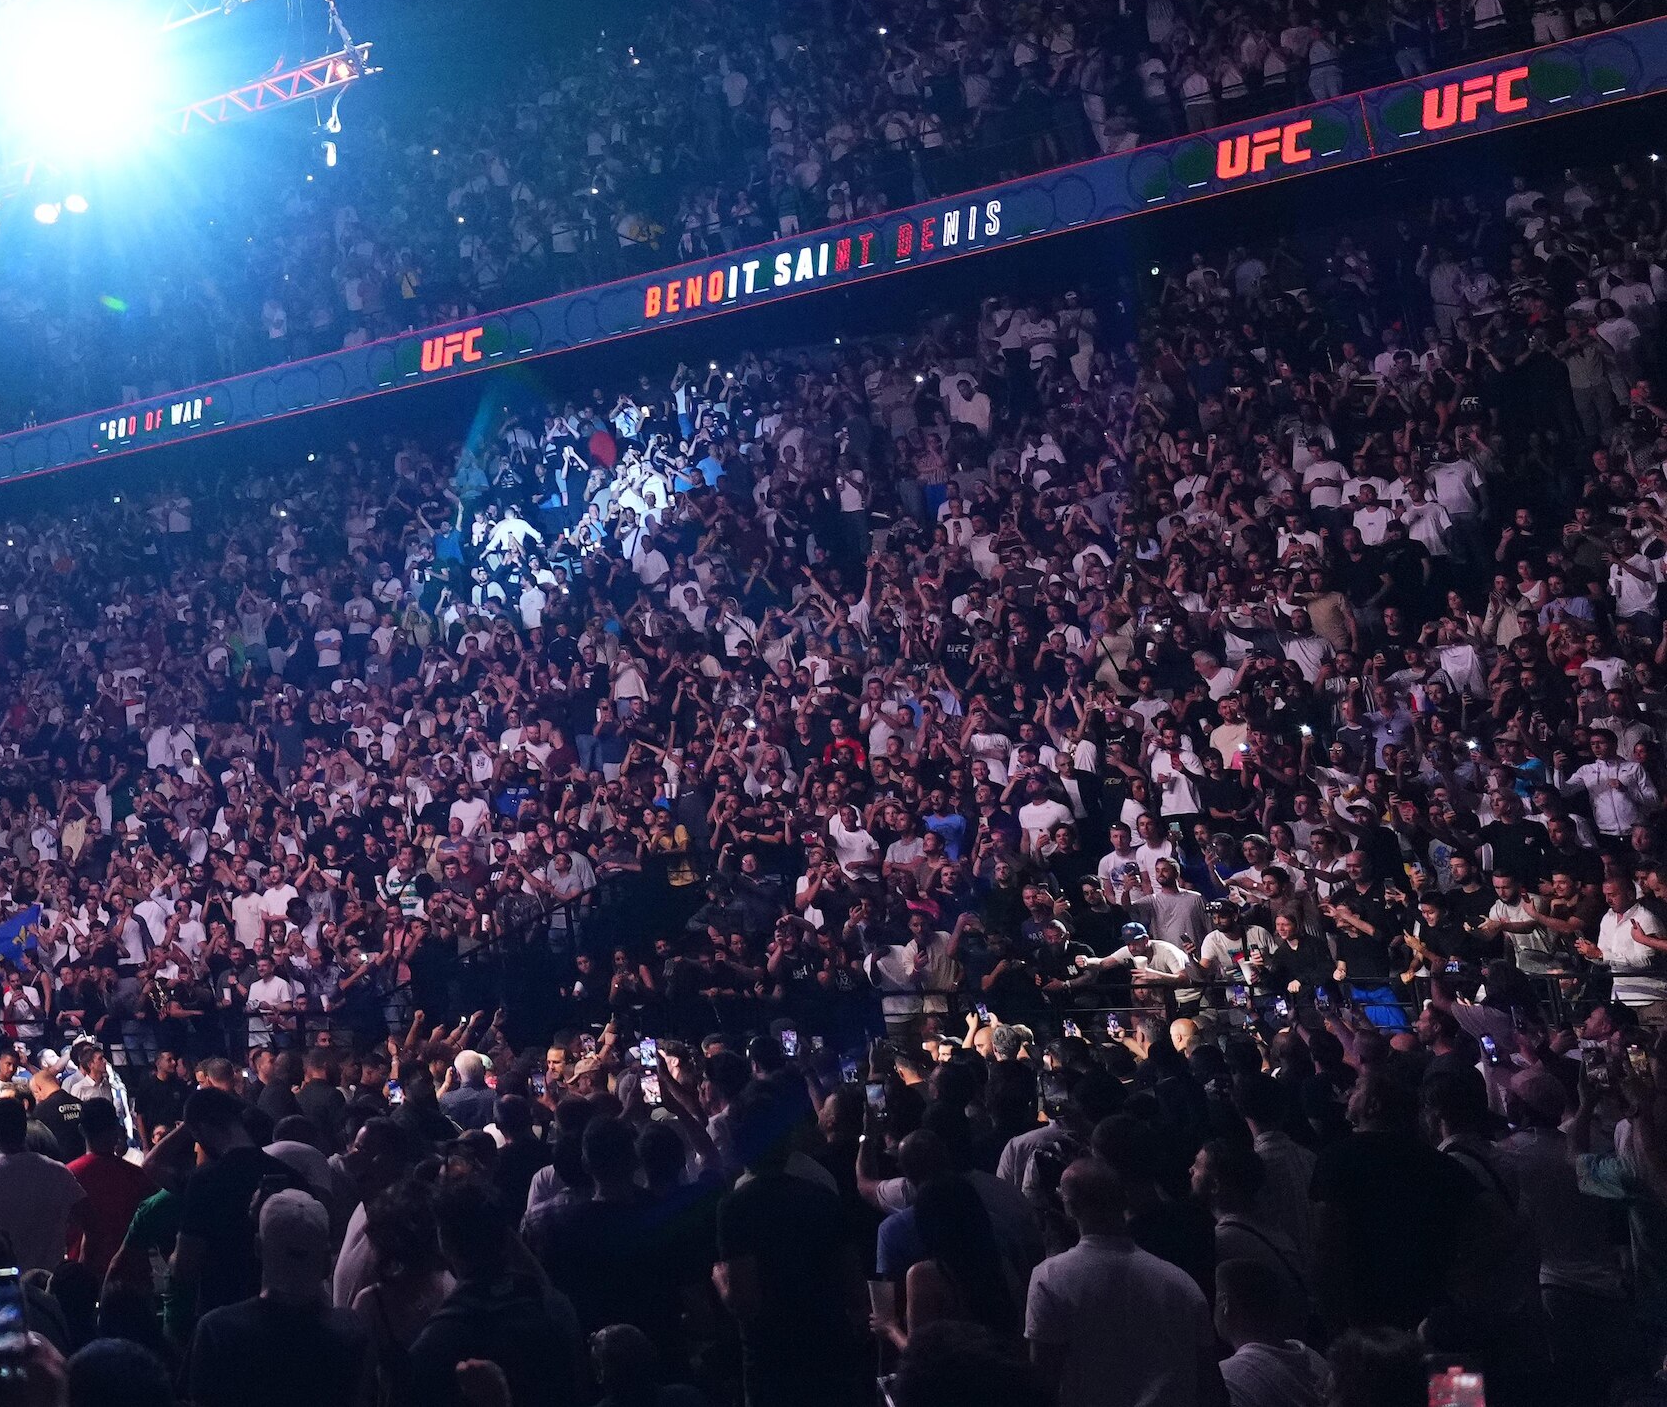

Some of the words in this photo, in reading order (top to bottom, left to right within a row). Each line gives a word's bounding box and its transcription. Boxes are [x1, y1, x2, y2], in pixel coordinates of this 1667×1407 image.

[1421, 66, 1529, 131] UFC
[1216, 119, 1313, 180] UFC
[645, 259, 760, 319] BENOIT
[774, 232, 875, 288] SAINT
[896, 199, 1002, 259] DENIS
[421, 327, 483, 372] UFC
[145, 410, 164, 432] OF
